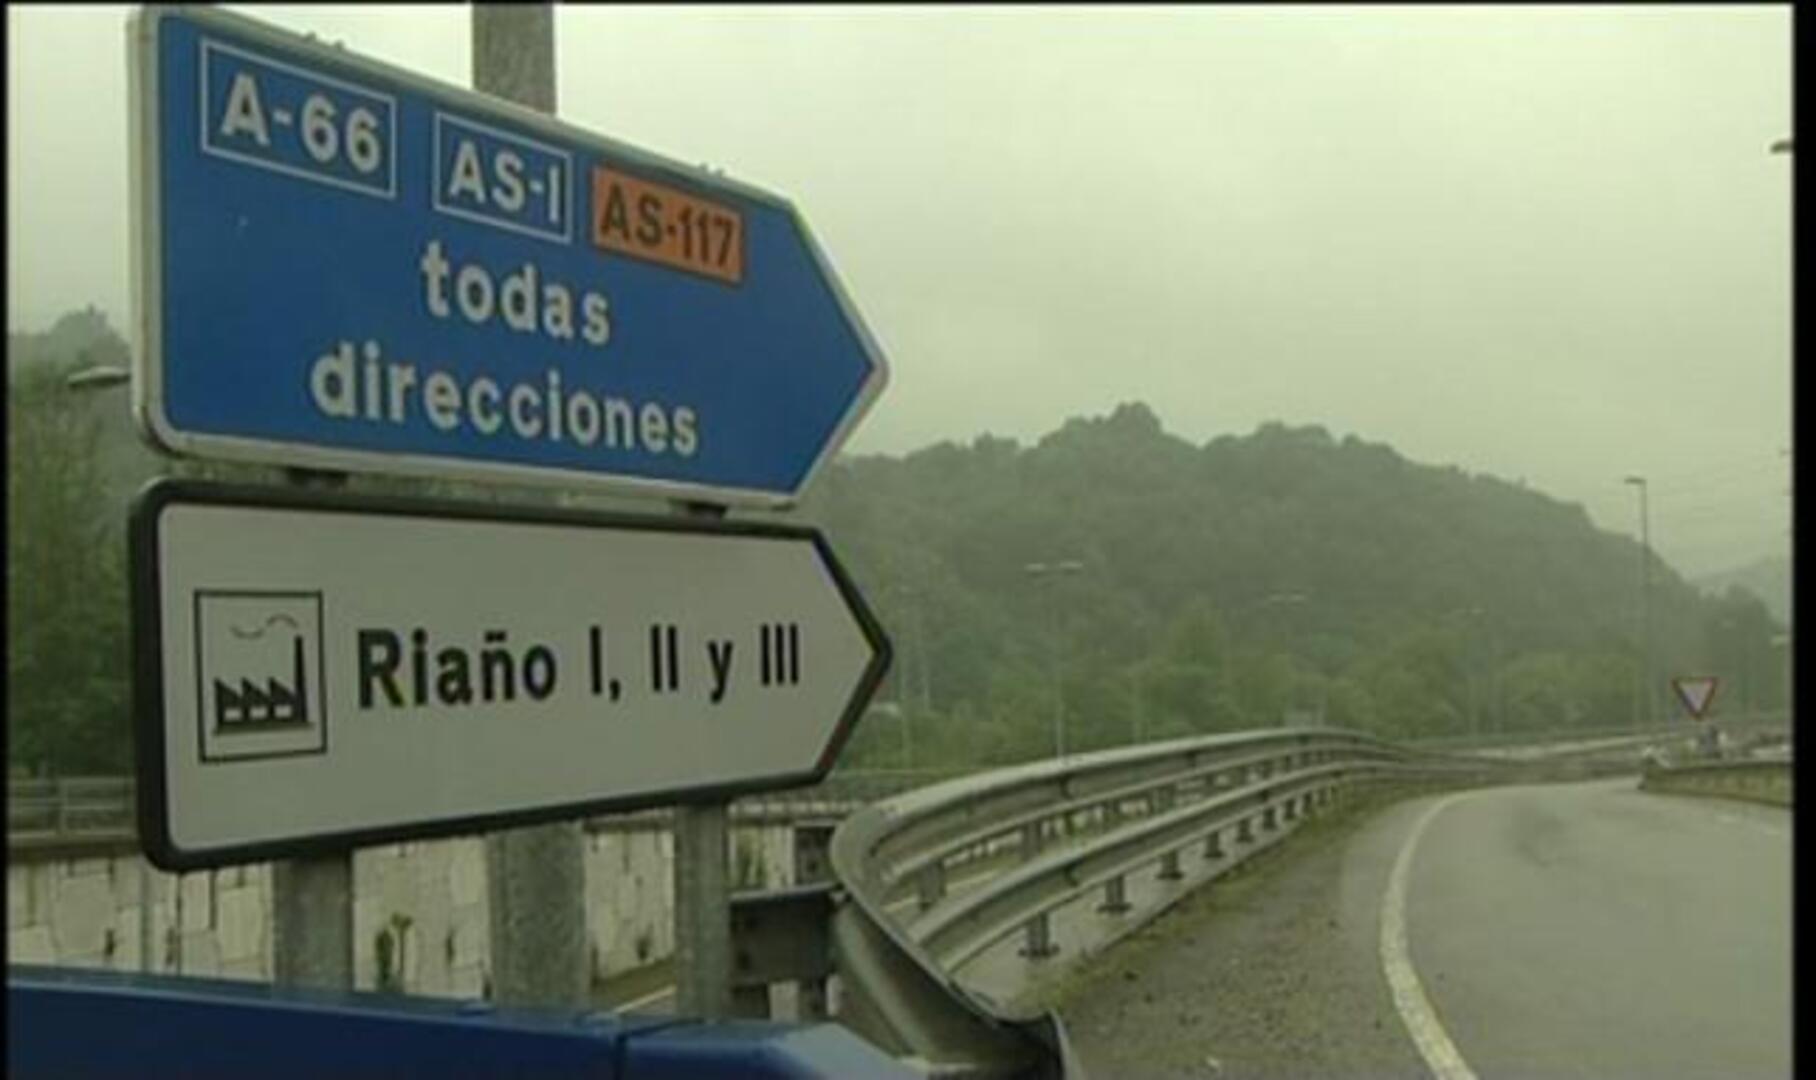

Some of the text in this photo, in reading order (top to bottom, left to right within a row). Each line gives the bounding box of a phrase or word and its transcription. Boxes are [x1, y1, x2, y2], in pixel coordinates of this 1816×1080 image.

[220, 73, 381, 174] A-66
[599, 184, 735, 268] AS-117
[421, 241, 611, 345] todas
[311, 340, 698, 455] direcciones
[357, 628, 557, 708] Riaño
[650, 624, 679, 692] II
[707, 640, 735, 703] y
[760, 623, 799, 686] III
